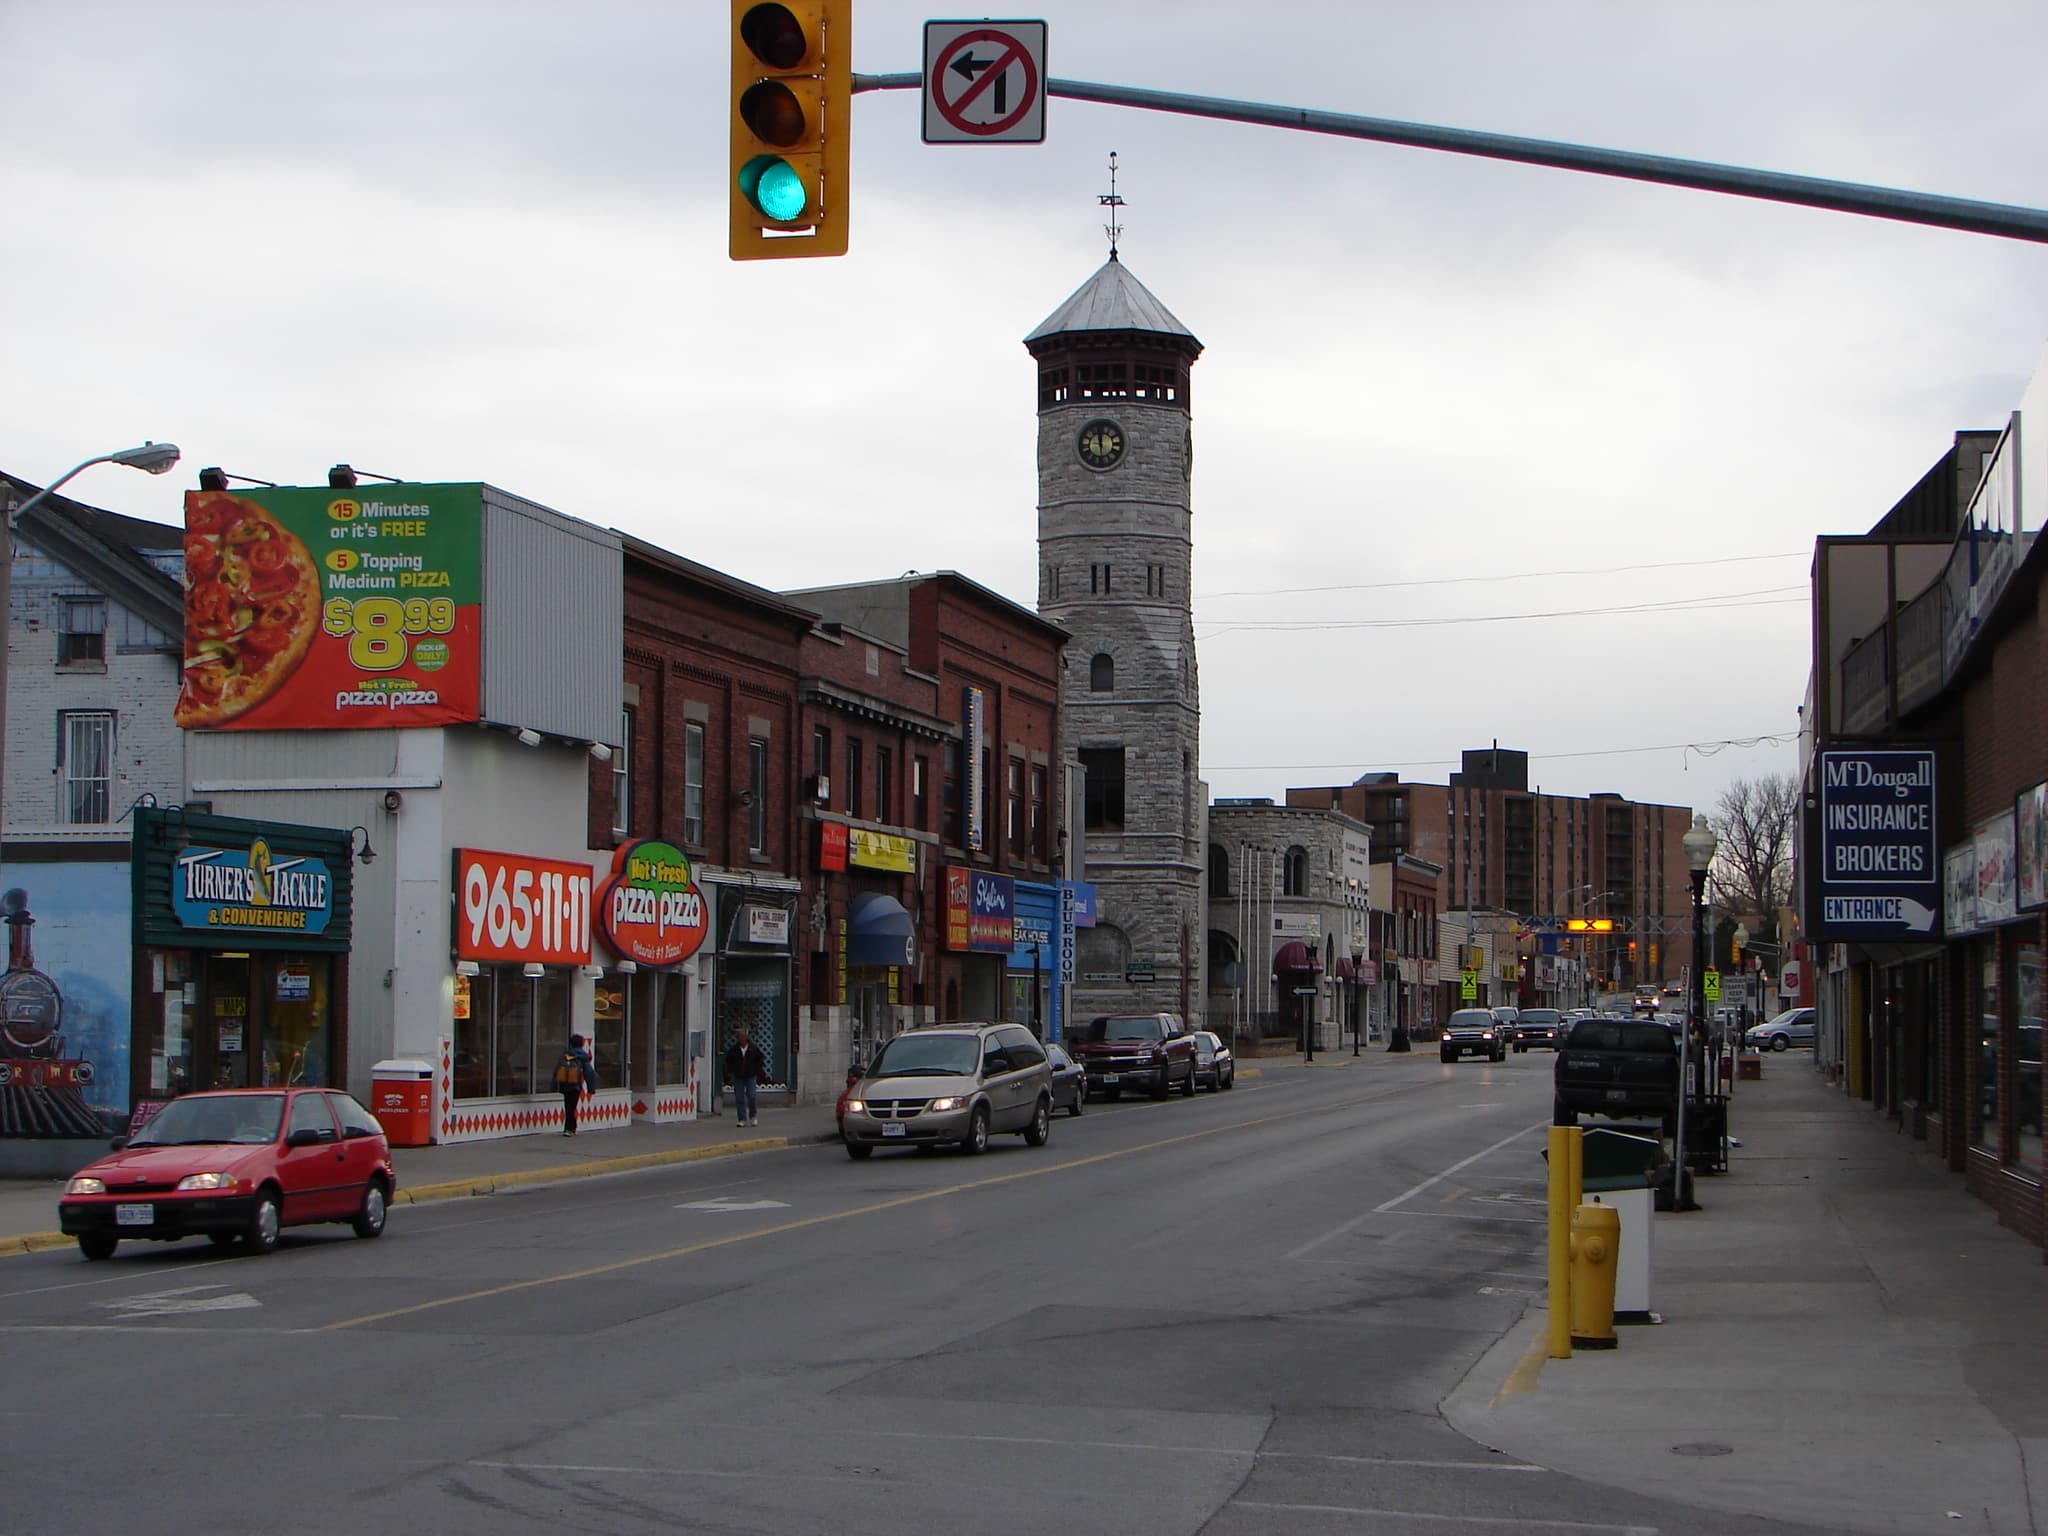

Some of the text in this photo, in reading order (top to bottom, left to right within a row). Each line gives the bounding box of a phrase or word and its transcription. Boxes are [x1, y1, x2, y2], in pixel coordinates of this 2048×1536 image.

[334, 502, 430, 518] 15 Minutes
[330, 521, 427, 538] or it's FREE
[337, 553, 423, 571] 5 Topping
[328, 571, 451, 589] Medium PIZZA
[387, 680, 418, 690] Fresh
[336, 690, 439, 711] pizza pizza
[1829, 804, 1929, 831] INSURANCE
[1835, 845, 1923, 871] BROKERS
[179, 850, 326, 908] TURNER'S TACKLE
[631, 857, 651, 881] Hot
[656, 858, 688, 885] Fresh
[208, 907, 306, 928] & CONVENIENCE
[613, 886, 701, 938] pizza pizza
[1826, 898, 1903, 920] ENTRANCE
[1028, 931, 1049, 945] HOUSE
[1062, 889, 1073, 982] BLUE ROOM
